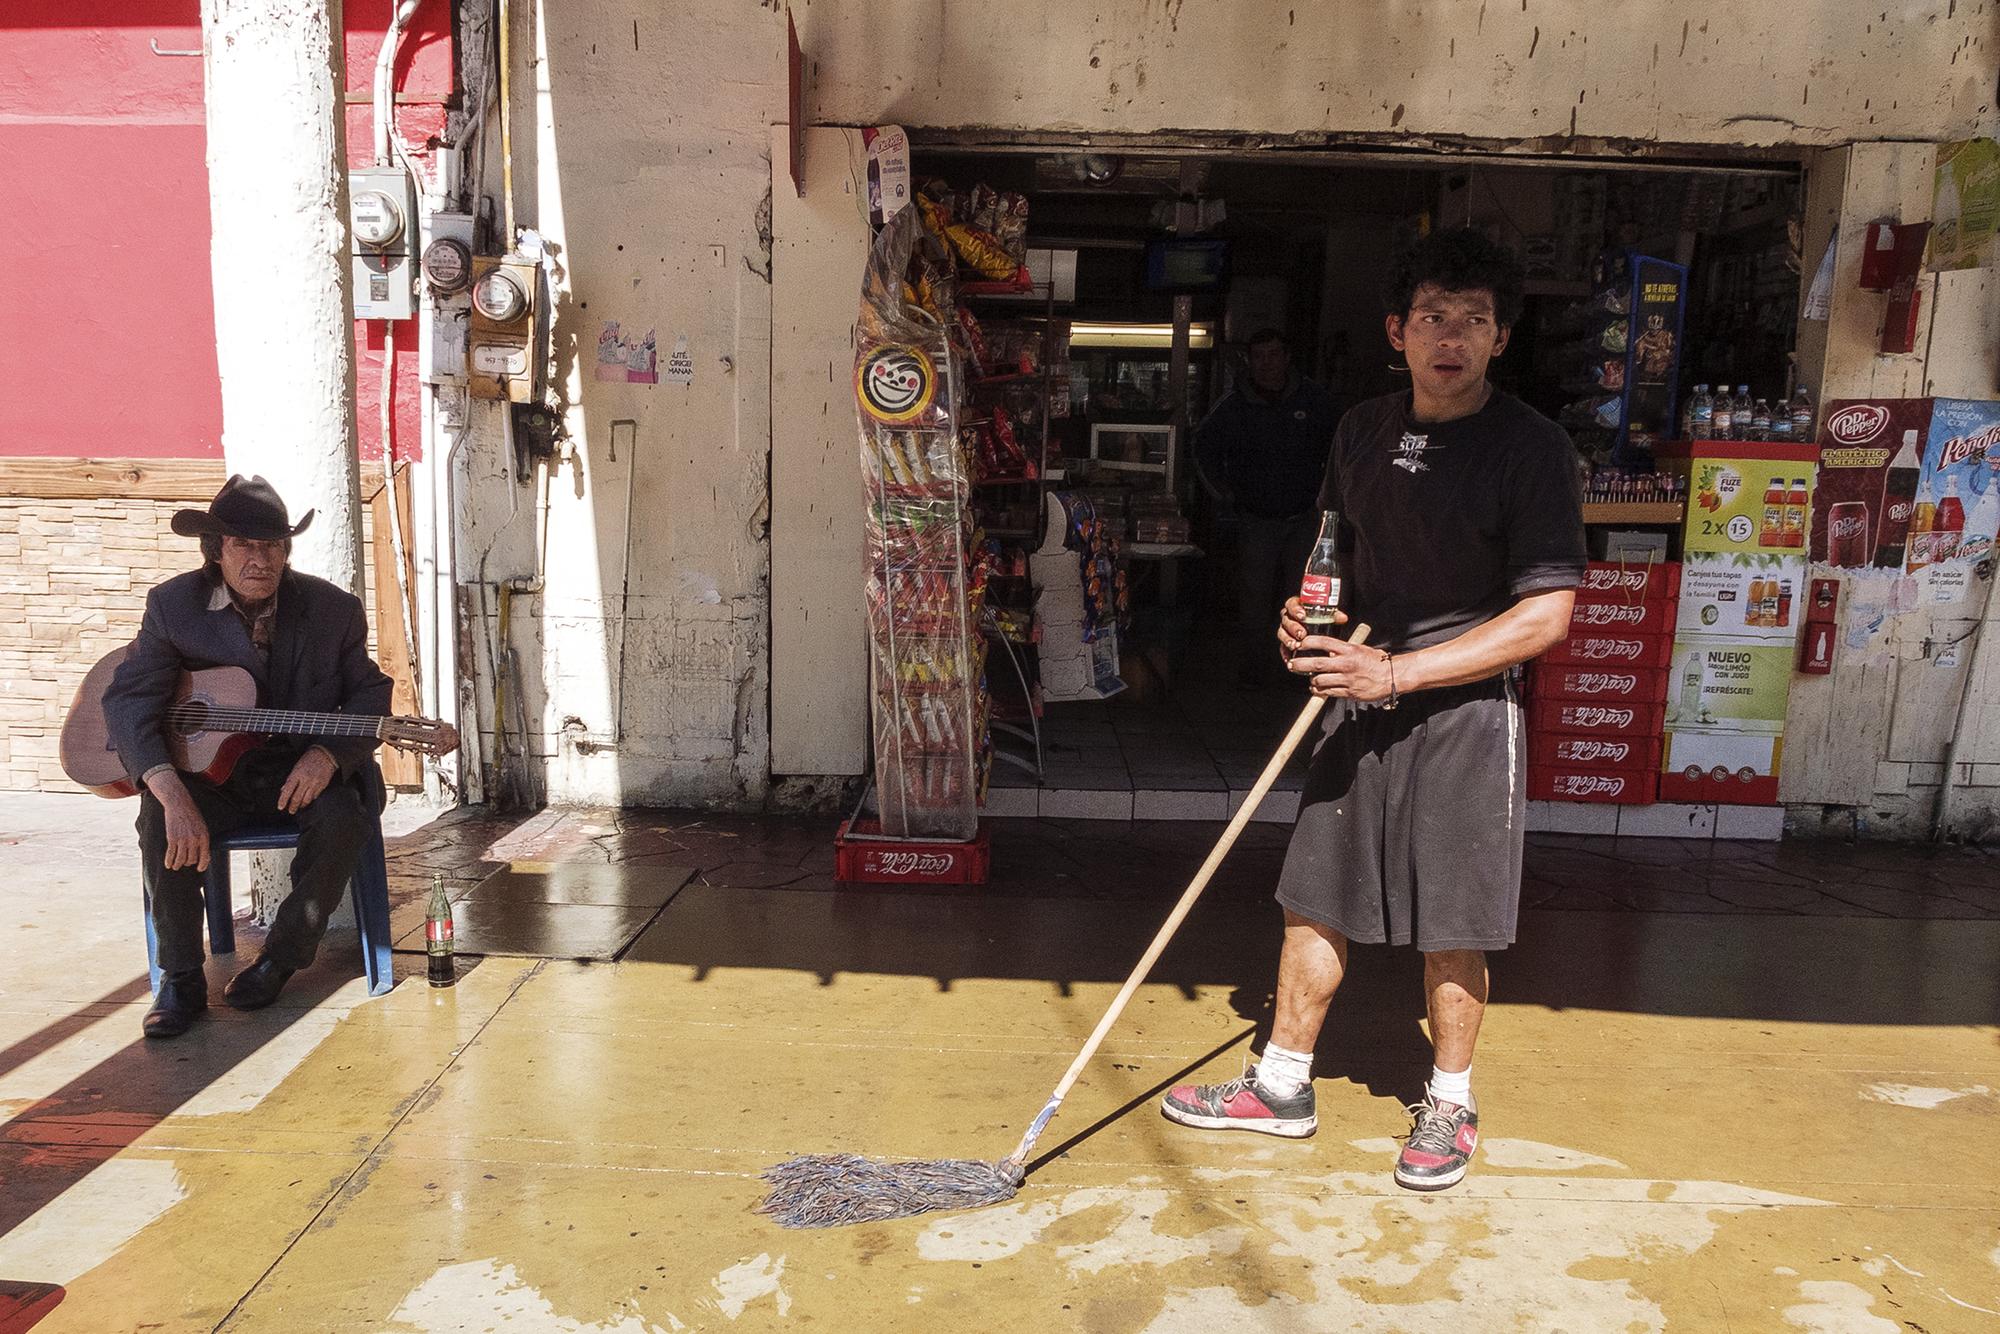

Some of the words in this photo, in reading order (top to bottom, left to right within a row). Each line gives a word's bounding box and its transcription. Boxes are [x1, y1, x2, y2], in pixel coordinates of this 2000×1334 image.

[1852, 411, 1869, 422] Dr
[1936, 409, 1946, 418] LA
[1947, 420, 1968, 428] CON
[1840, 414, 1878, 437] Pepper
[1935, 423, 2000, 472] Peñafi
[1721, 478, 1742, 487] FUZE
[1586, 569, 1648, 591] Coca-Cola
[1584, 604, 1646, 625] Coca-Cola
[1582, 639, 1643, 660] Coca-Cola
[1708, 651, 1752, 663] NUEVO
[1714, 671, 1729, 679] CON
[1725, 664, 1751, 672] LIMÓN
[1575, 673, 1637, 695] Coca-Cola
[1572, 706, 1634, 729] Coca-Cola
[1568, 741, 1630, 762] Coca-Cola
[1564, 775, 1625, 796] Coca-Cola
[878, 851, 954, 875] Coca-Cola
